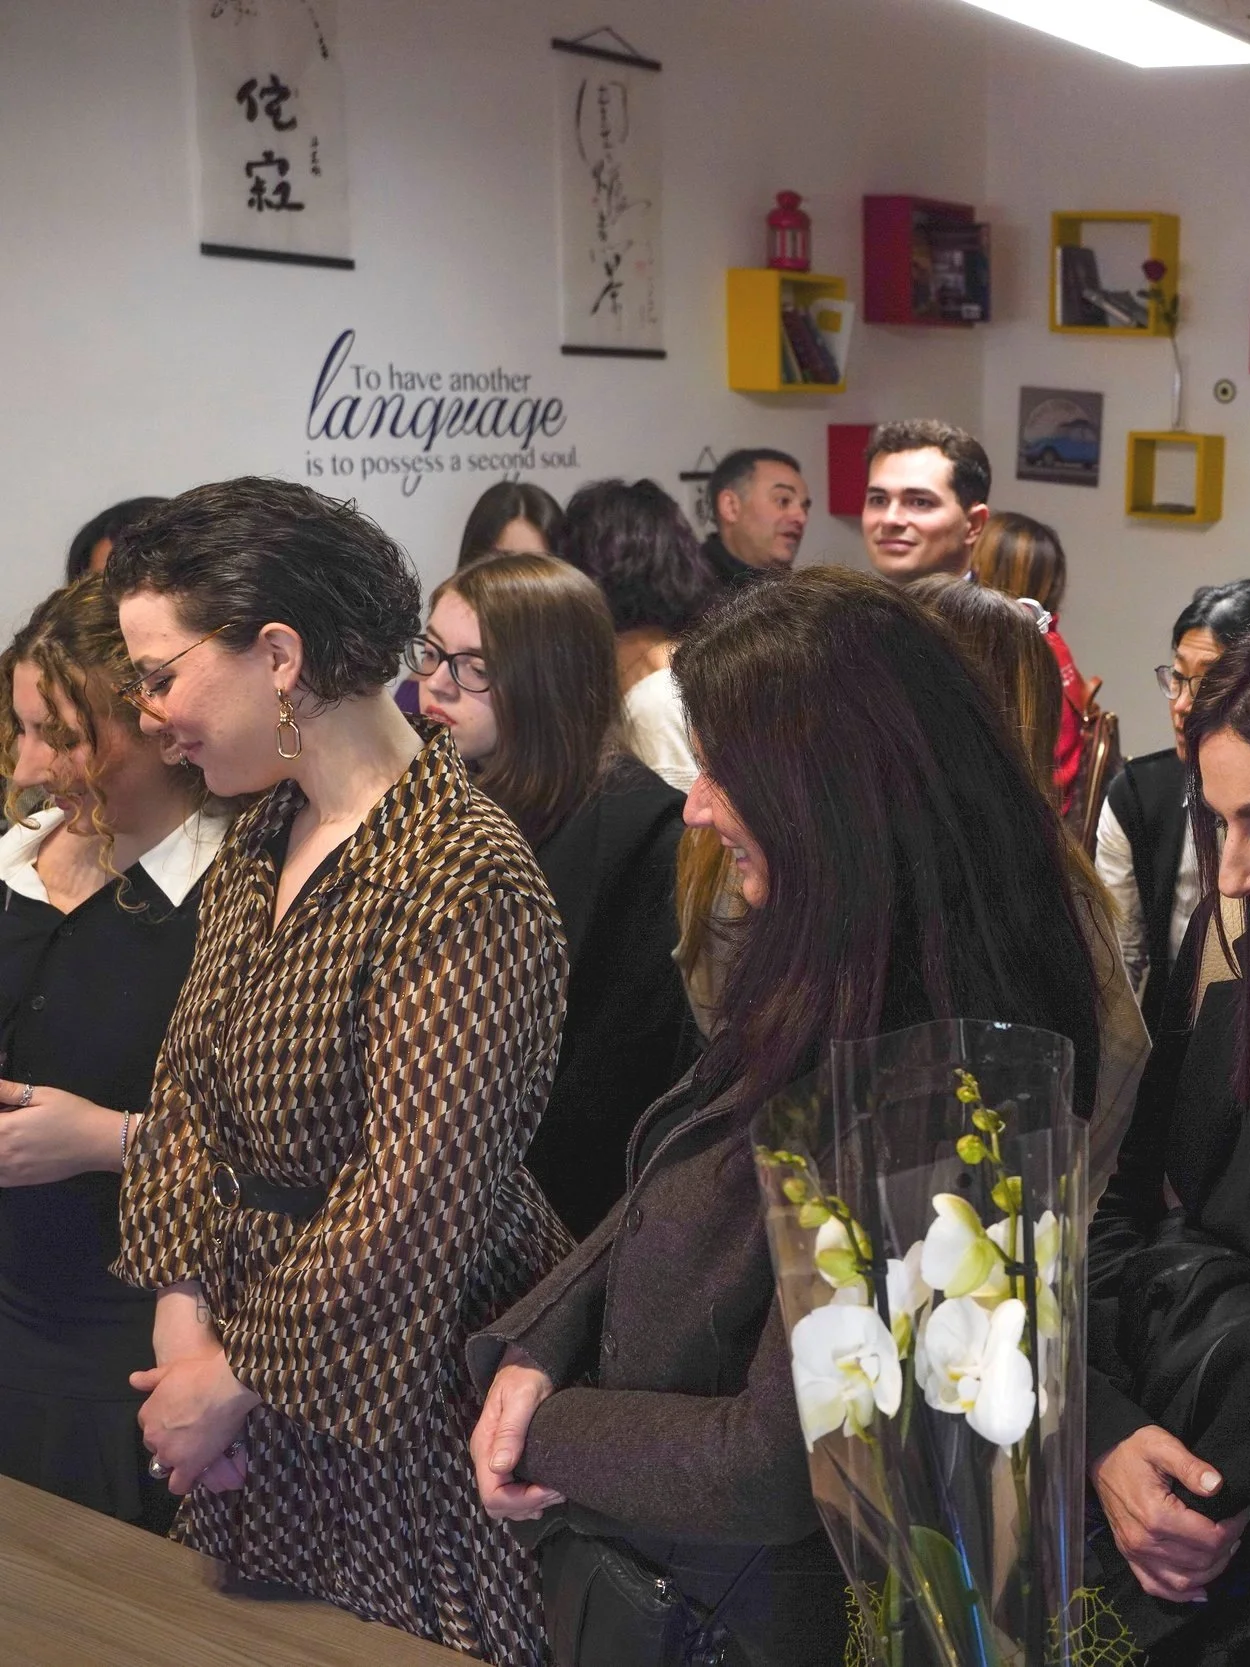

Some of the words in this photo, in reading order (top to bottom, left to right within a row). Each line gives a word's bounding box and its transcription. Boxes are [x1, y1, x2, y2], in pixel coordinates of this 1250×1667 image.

[351, 365, 381, 390] To
[389, 362, 442, 391] have
[449, 366, 531, 393] another
[307, 329, 567, 497] language
[306, 451, 323, 476] is
[331, 453, 354, 475] to
[361, 453, 444, 481] possess
[450, 454, 461, 471] a
[468, 450, 535, 471] second
